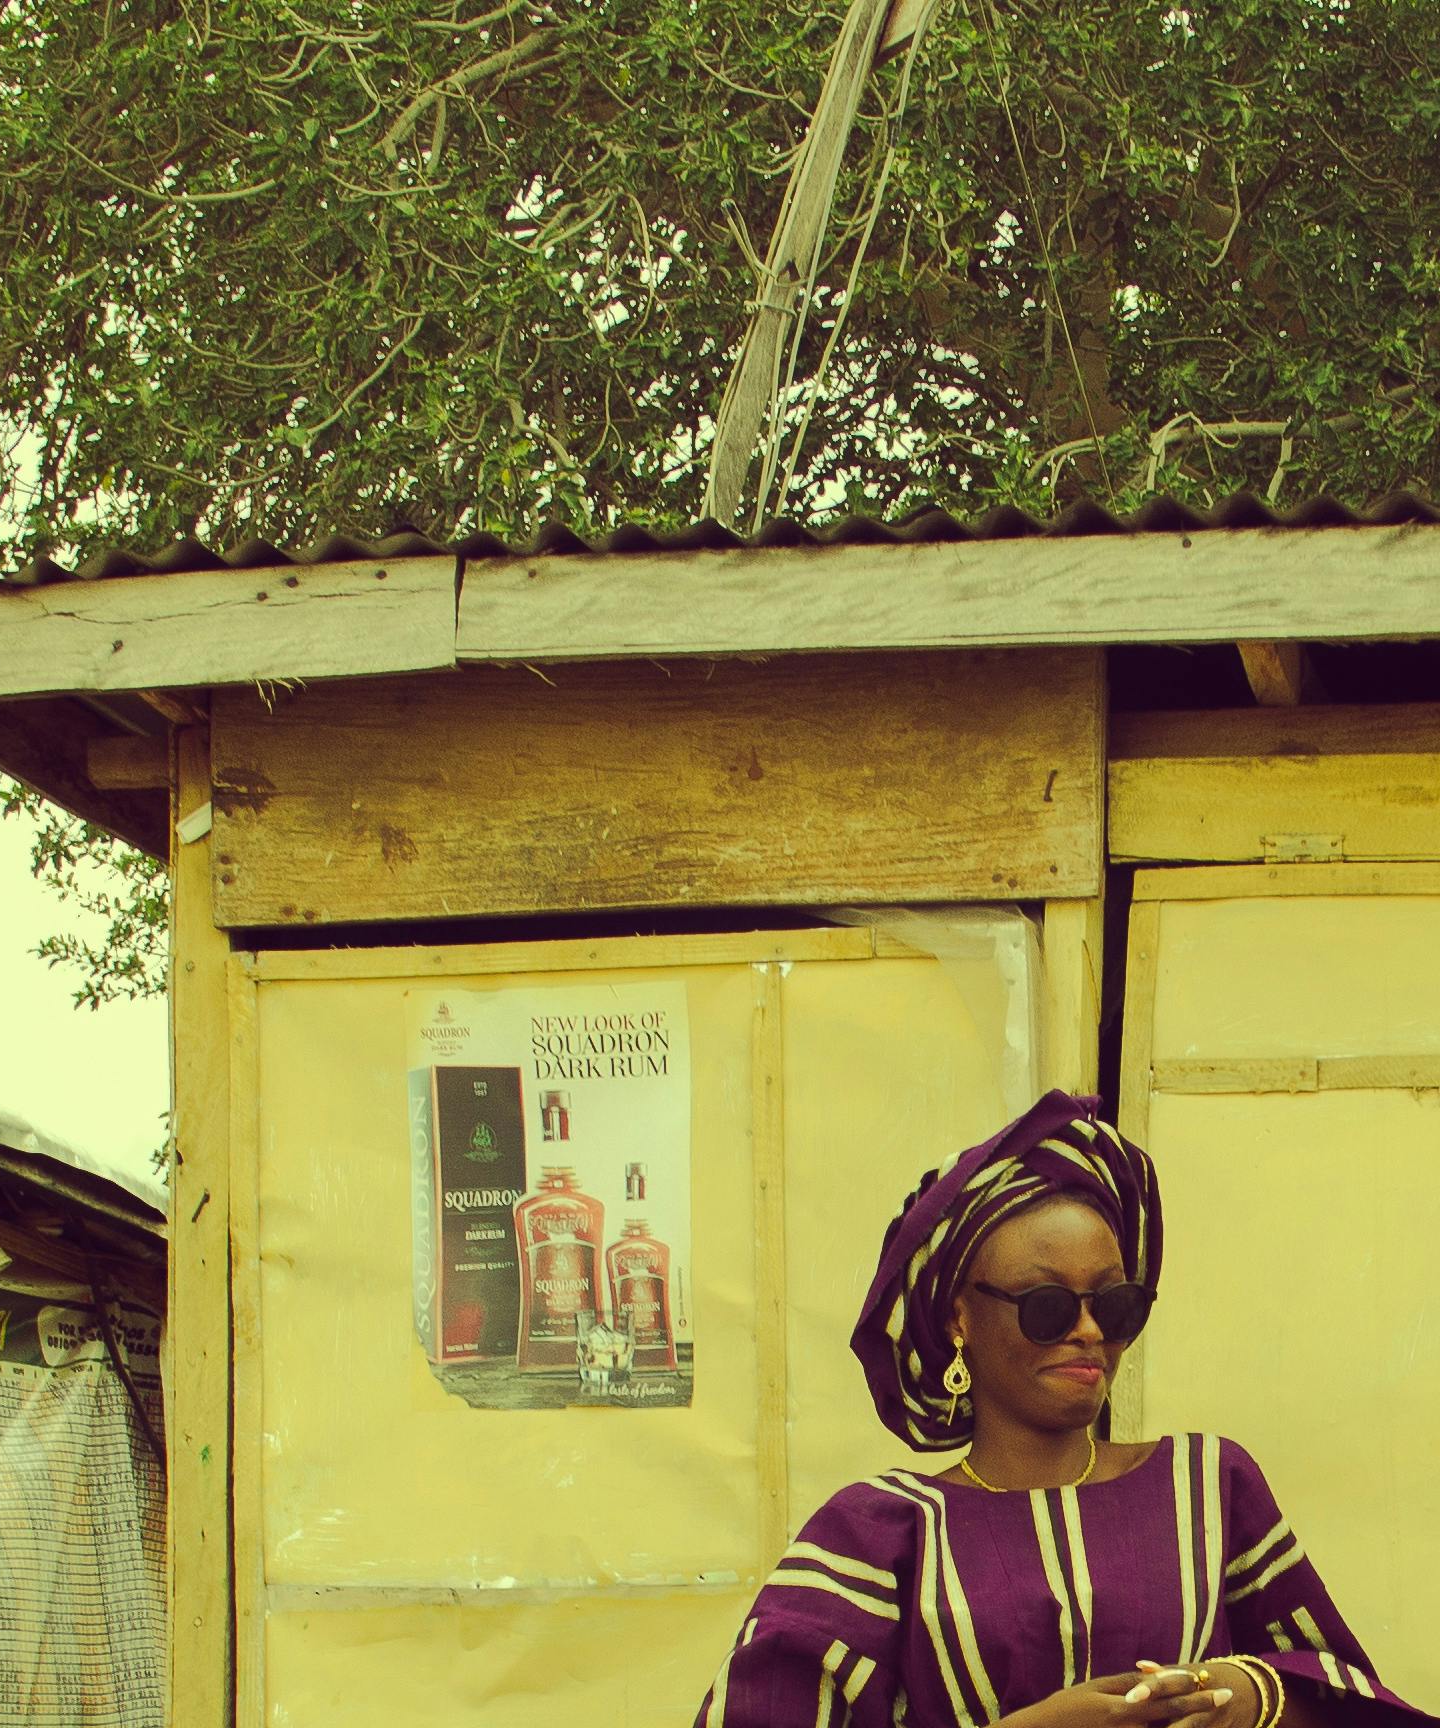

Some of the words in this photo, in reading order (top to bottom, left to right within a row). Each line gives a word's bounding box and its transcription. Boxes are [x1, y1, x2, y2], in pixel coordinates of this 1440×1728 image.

[420, 1026, 471, 1041] SQUADRON
[531, 1016, 578, 1034] NEW
[582, 1013, 637, 1032] LOOK
[640, 1011, 667, 1030] OF
[532, 1030, 670, 1061] SQUADRON
[535, 1057, 604, 1081] DARK
[610, 1055, 669, 1078] RUM
[413, 1096, 435, 1333] SQUADRON
[534, 1278, 589, 1295] SQUADRON
